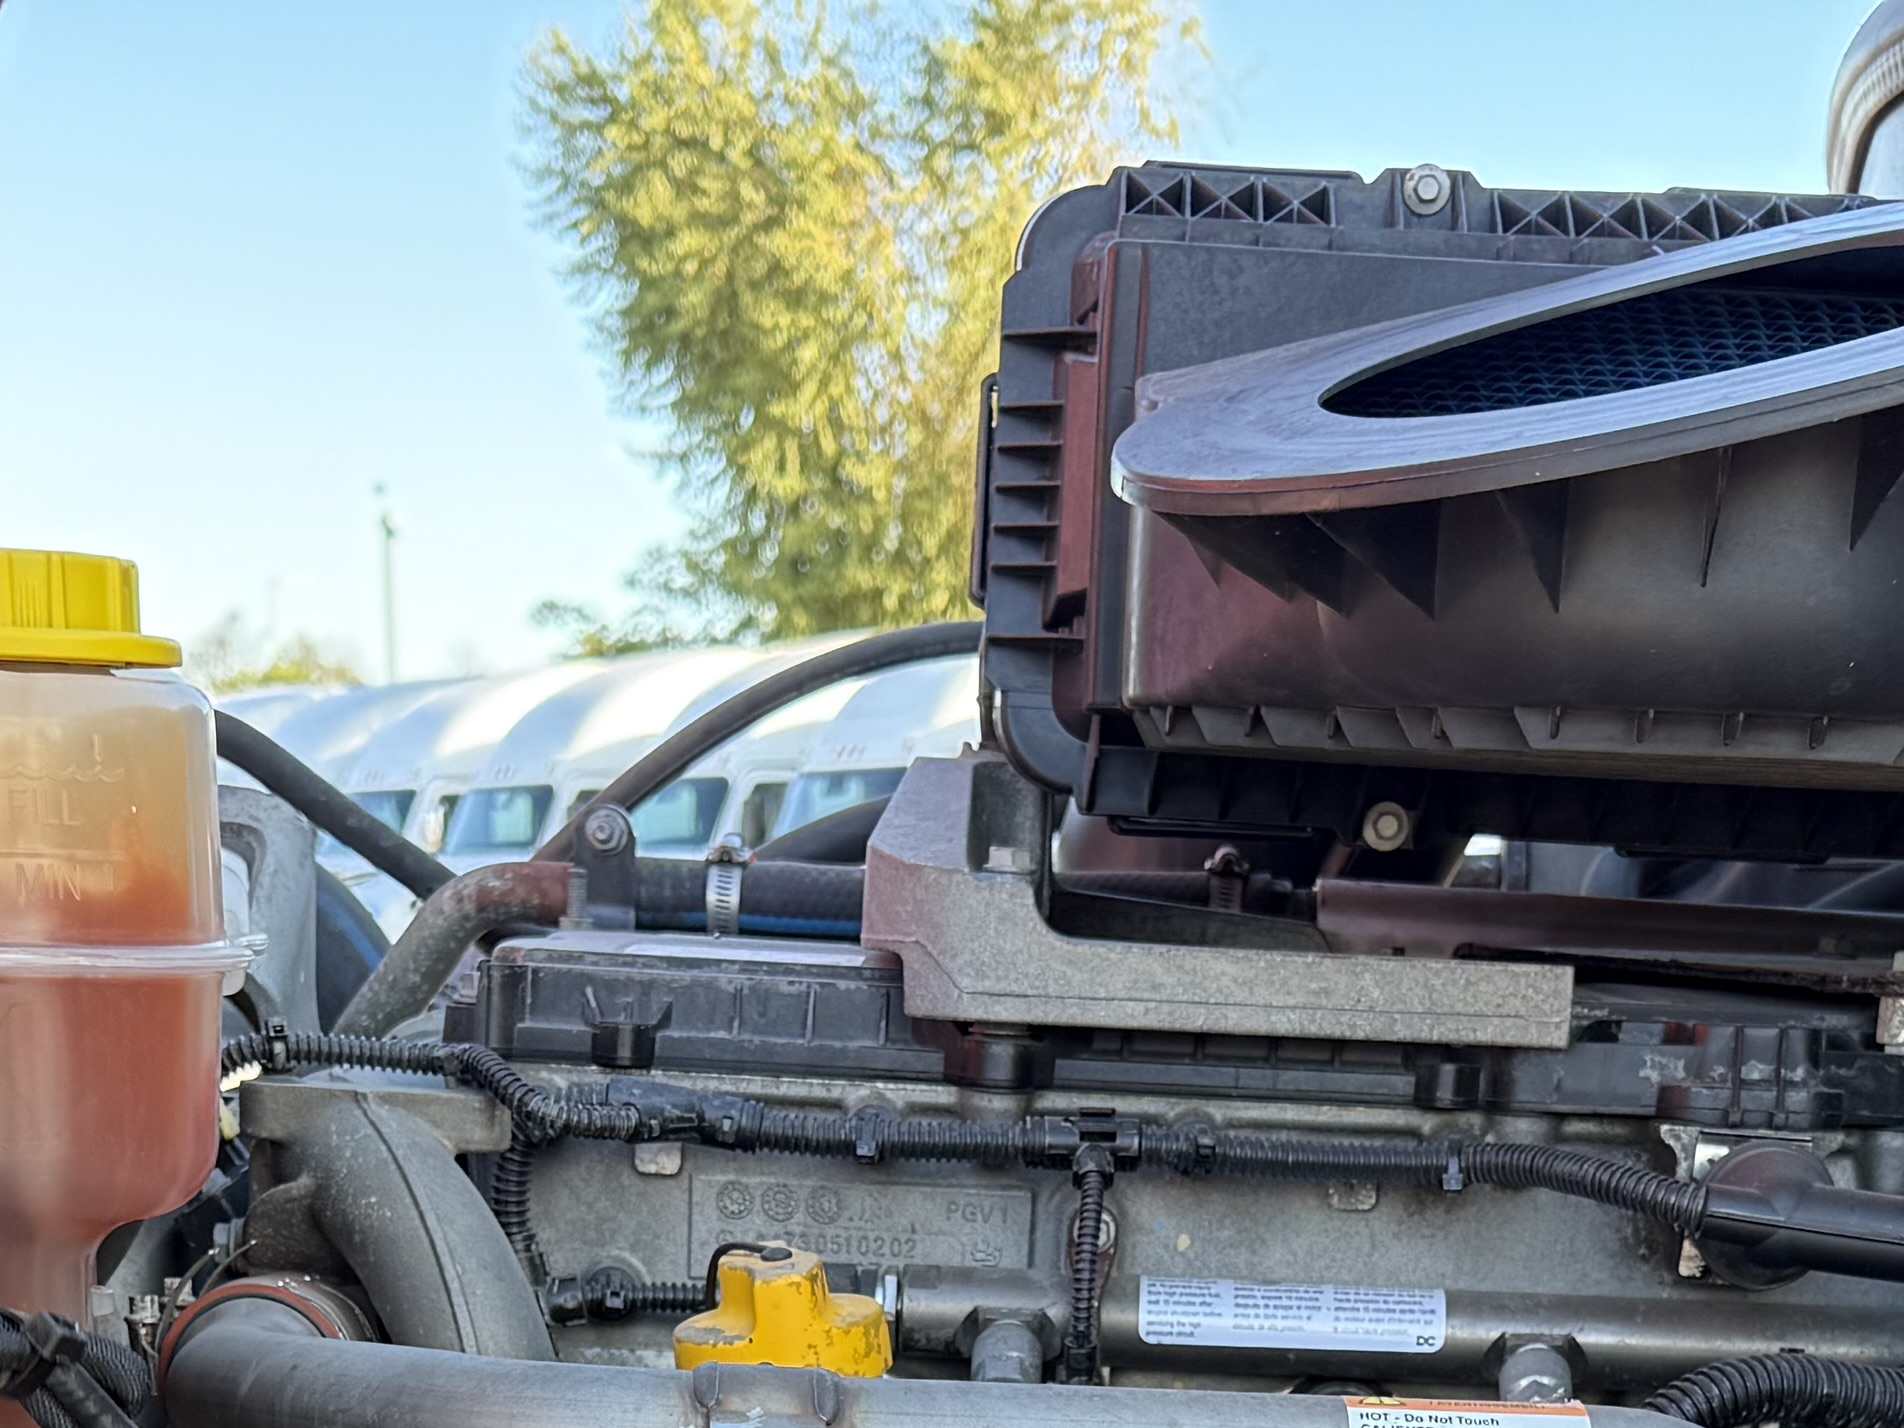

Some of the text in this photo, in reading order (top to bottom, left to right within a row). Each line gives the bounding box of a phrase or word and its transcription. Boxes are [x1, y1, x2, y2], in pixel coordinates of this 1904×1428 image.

[1359, 1412, 1500, 1427] HOT Do Not Touch
